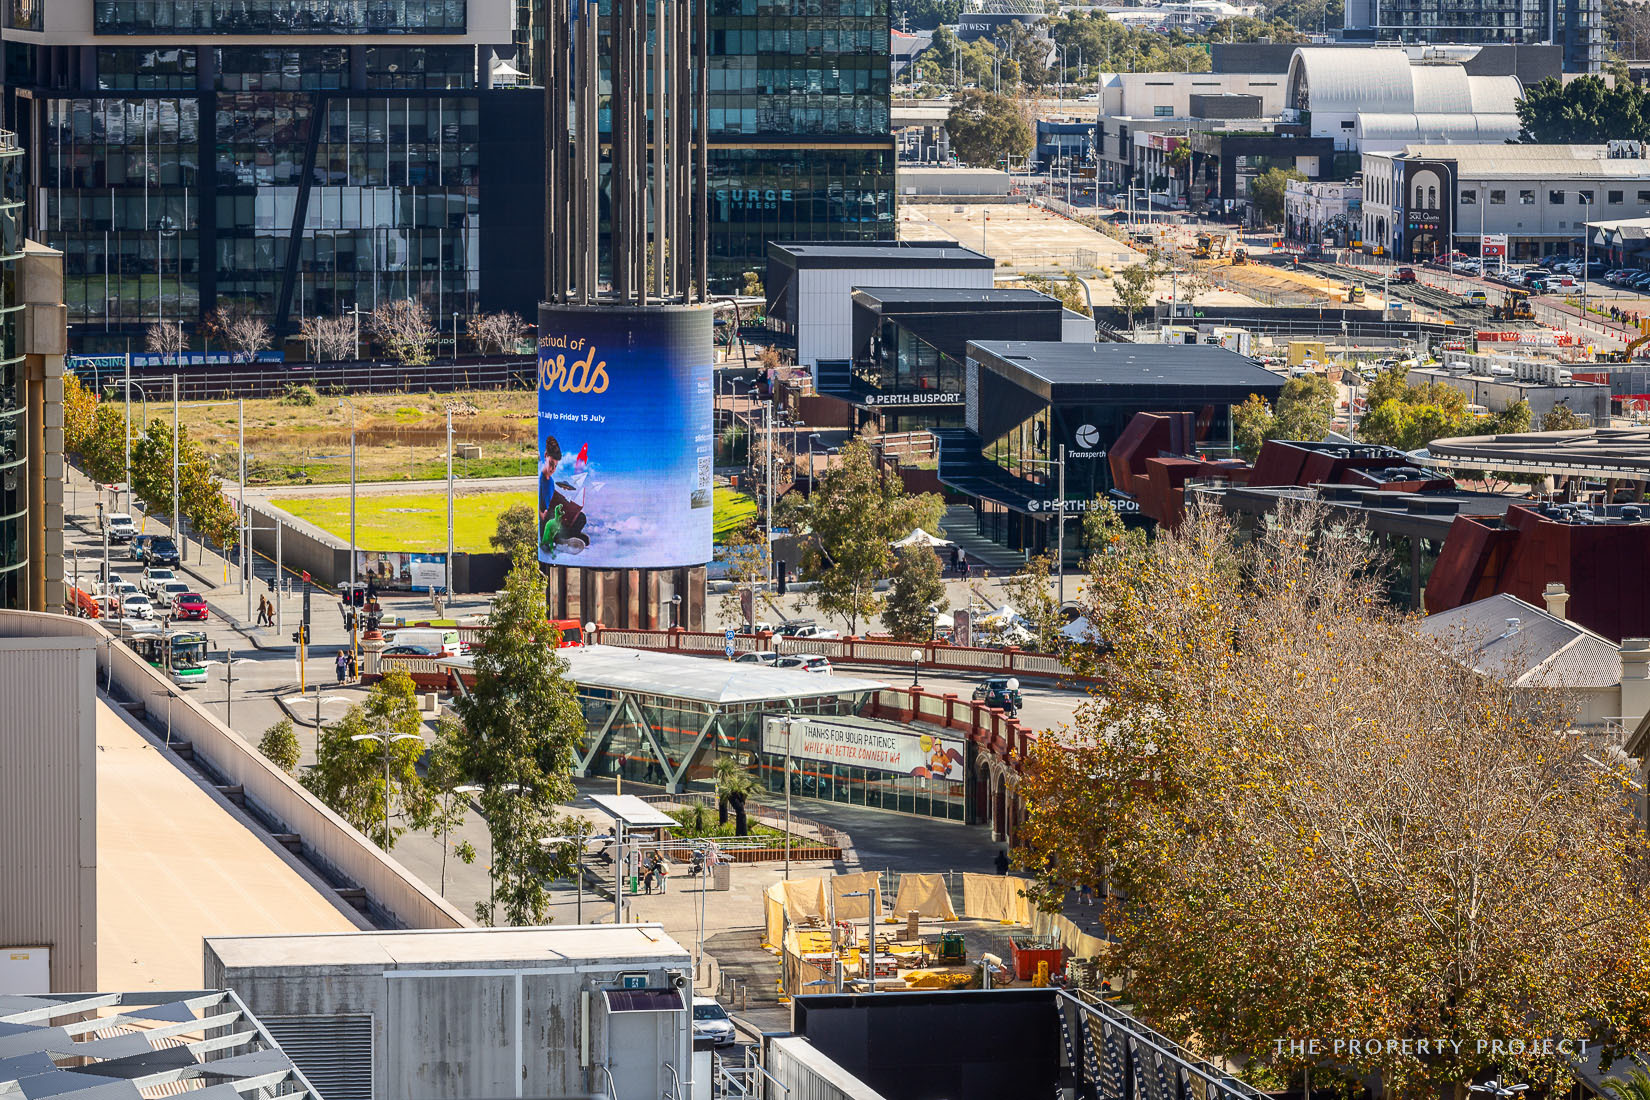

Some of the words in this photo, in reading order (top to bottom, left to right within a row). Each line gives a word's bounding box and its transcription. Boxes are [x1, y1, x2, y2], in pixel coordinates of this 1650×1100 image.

[969, 23, 991, 31] WEST
[715, 189, 793, 201] SURGE
[570, 338, 586, 351] of
[876, 394, 910, 404] PERTH
[912, 393, 960, 403] BUSPORT
[559, 413, 580, 423] Friday
[590, 414, 606, 424] July
[1068, 449, 1107, 460] Transperth
[1043, 499, 1086, 511] PERTH
[804, 725, 830, 740] THANKS
[830, 729, 844, 742] FOR
[845, 731, 863, 745] YOUR
[864, 734, 896, 750] PATIENCE
[803, 740, 823, 754] WHILE
[825, 743, 834, 755] WE
[835, 744, 857, 759] BETTER
[857, 748, 889, 763] CONNECT
[889, 752, 901, 765] WA
